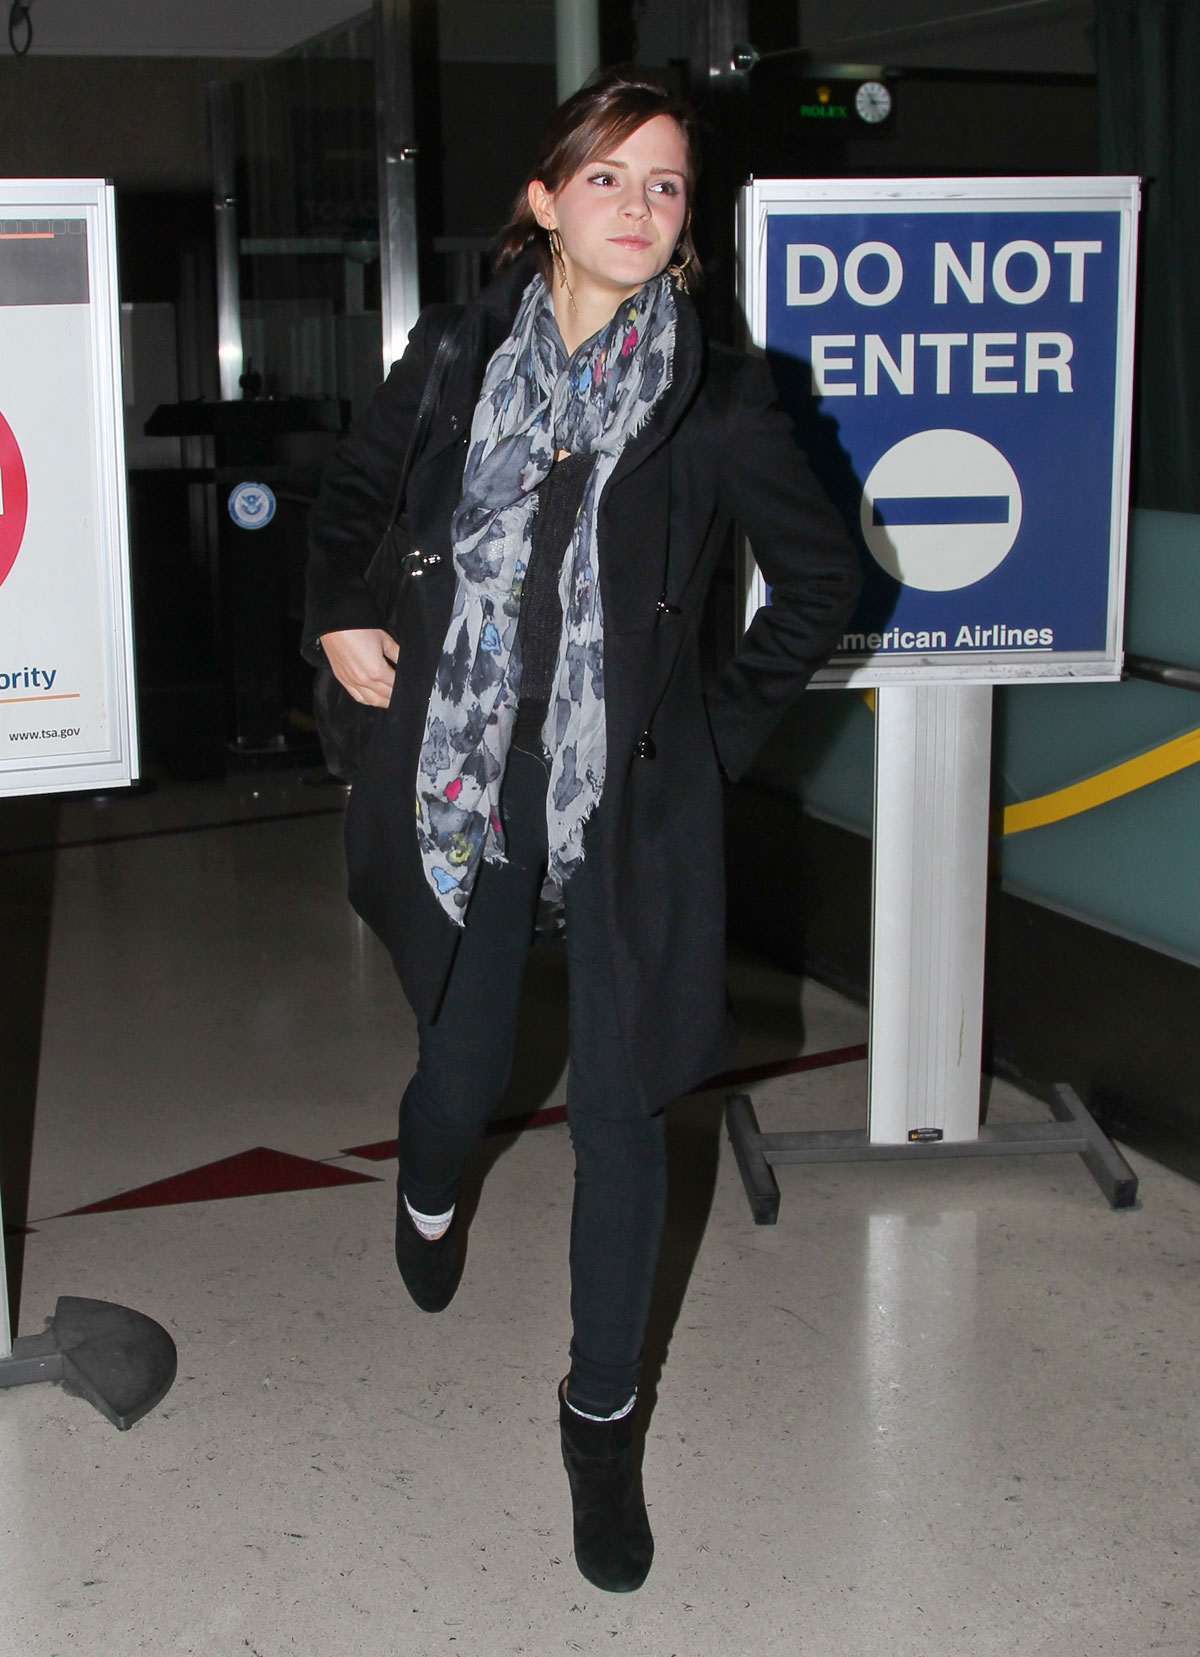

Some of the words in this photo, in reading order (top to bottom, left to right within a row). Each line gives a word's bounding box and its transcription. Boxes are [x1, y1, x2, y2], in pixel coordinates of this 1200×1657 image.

[801, 104, 847, 118] ROLEX
[786, 241, 904, 308] DO
[933, 240, 1102, 305] NOT
[811, 332, 1075, 397] ENTER
[836, 627, 947, 650] merican
[954, 624, 1054, 648] Airlines
[9, 727, 81, 742] www.tsa.gov
